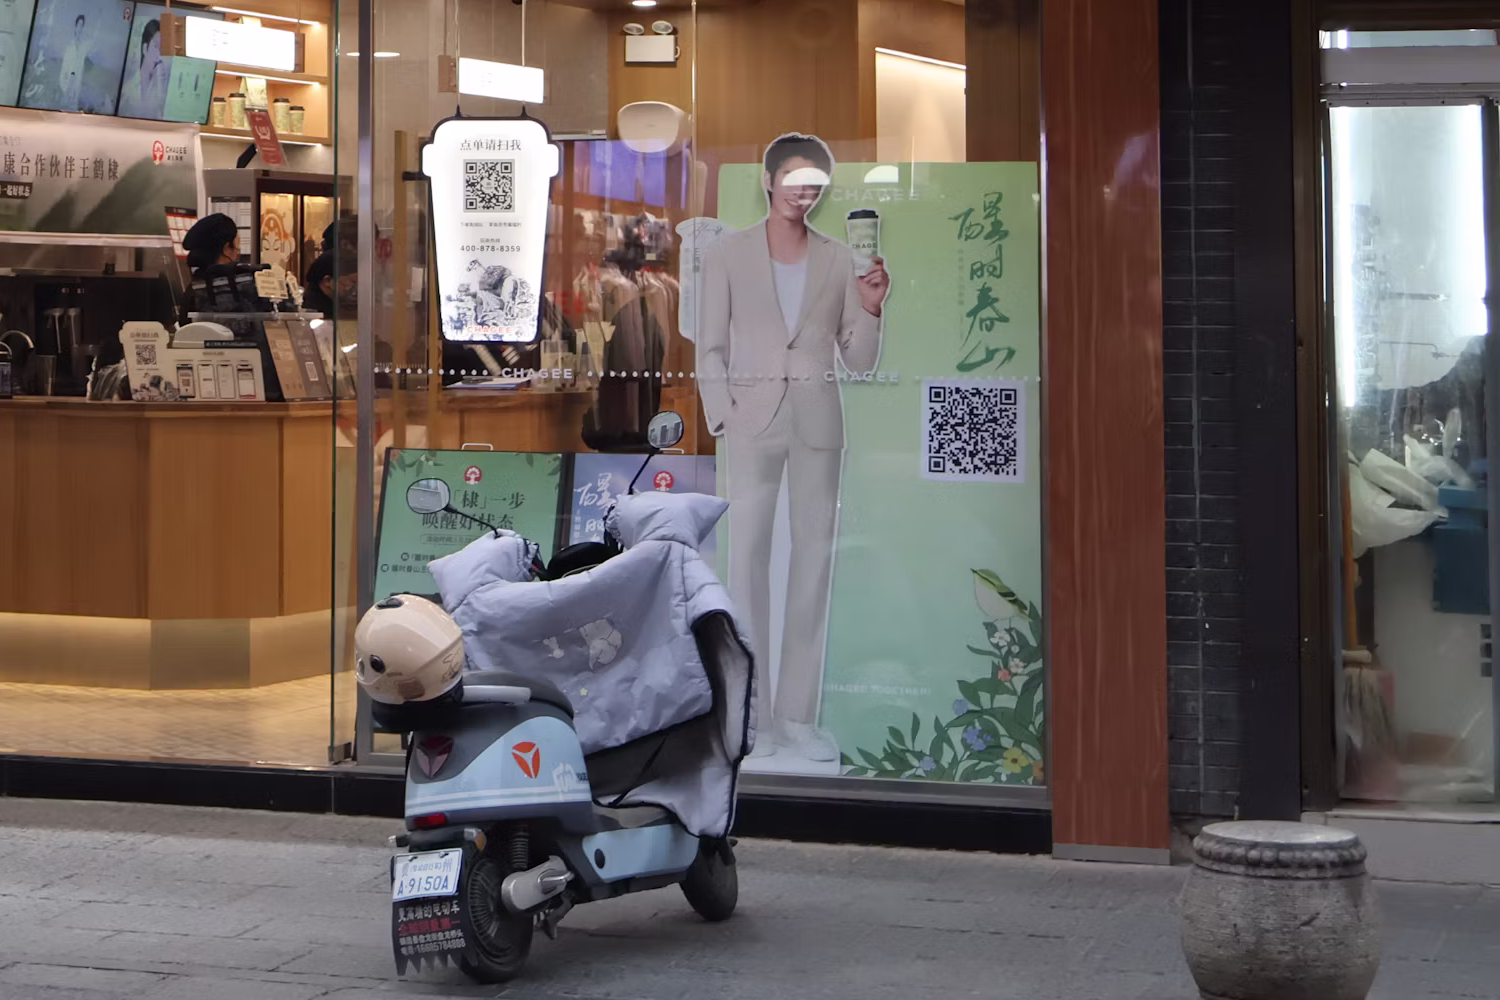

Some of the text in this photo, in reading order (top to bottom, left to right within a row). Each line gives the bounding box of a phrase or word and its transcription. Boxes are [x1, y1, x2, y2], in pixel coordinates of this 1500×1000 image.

[459, 138, 522, 152] 点单请扫我
[501, 367, 573, 379] CHAGEE
[824, 371, 900, 383] CHAGEE
